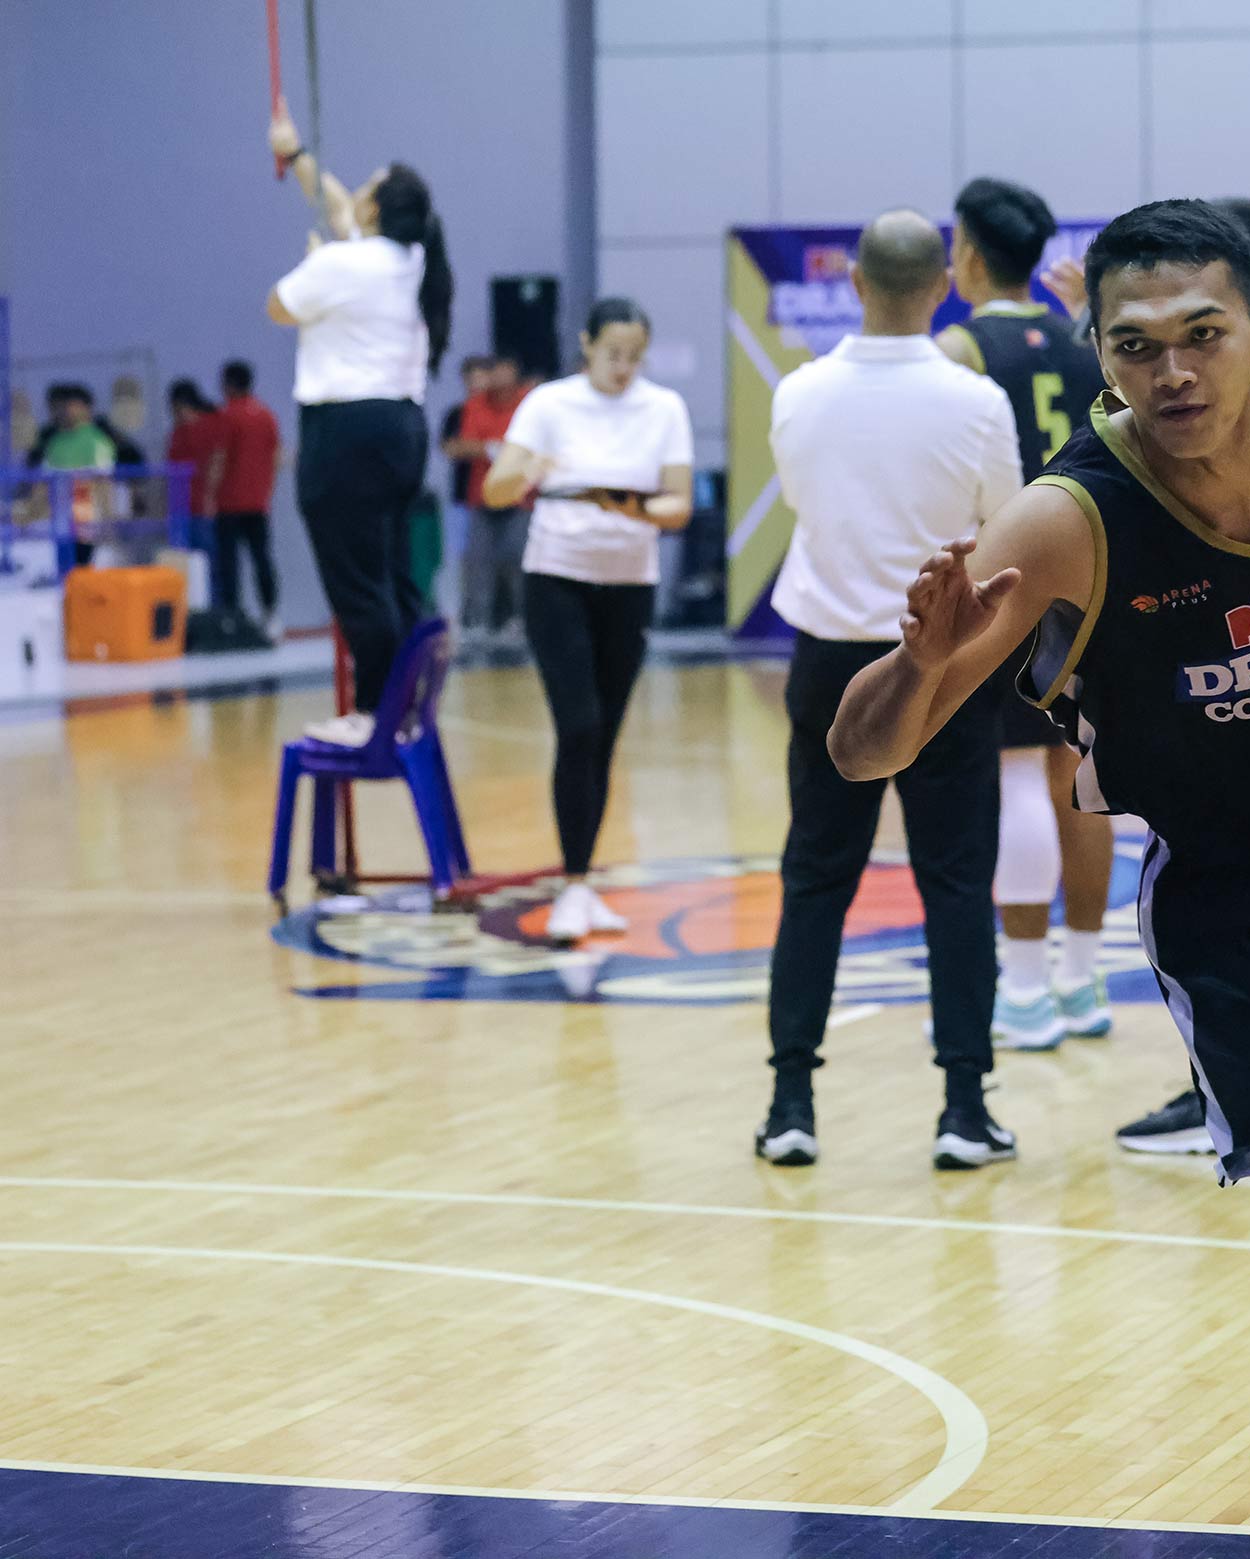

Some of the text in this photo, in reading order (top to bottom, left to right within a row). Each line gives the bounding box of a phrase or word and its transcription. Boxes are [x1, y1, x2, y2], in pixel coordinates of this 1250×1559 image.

[1032, 373, 1071, 466] 5
[1162, 579, 1212, 604] ARENA
[1171, 593, 1207, 609] PLUS
